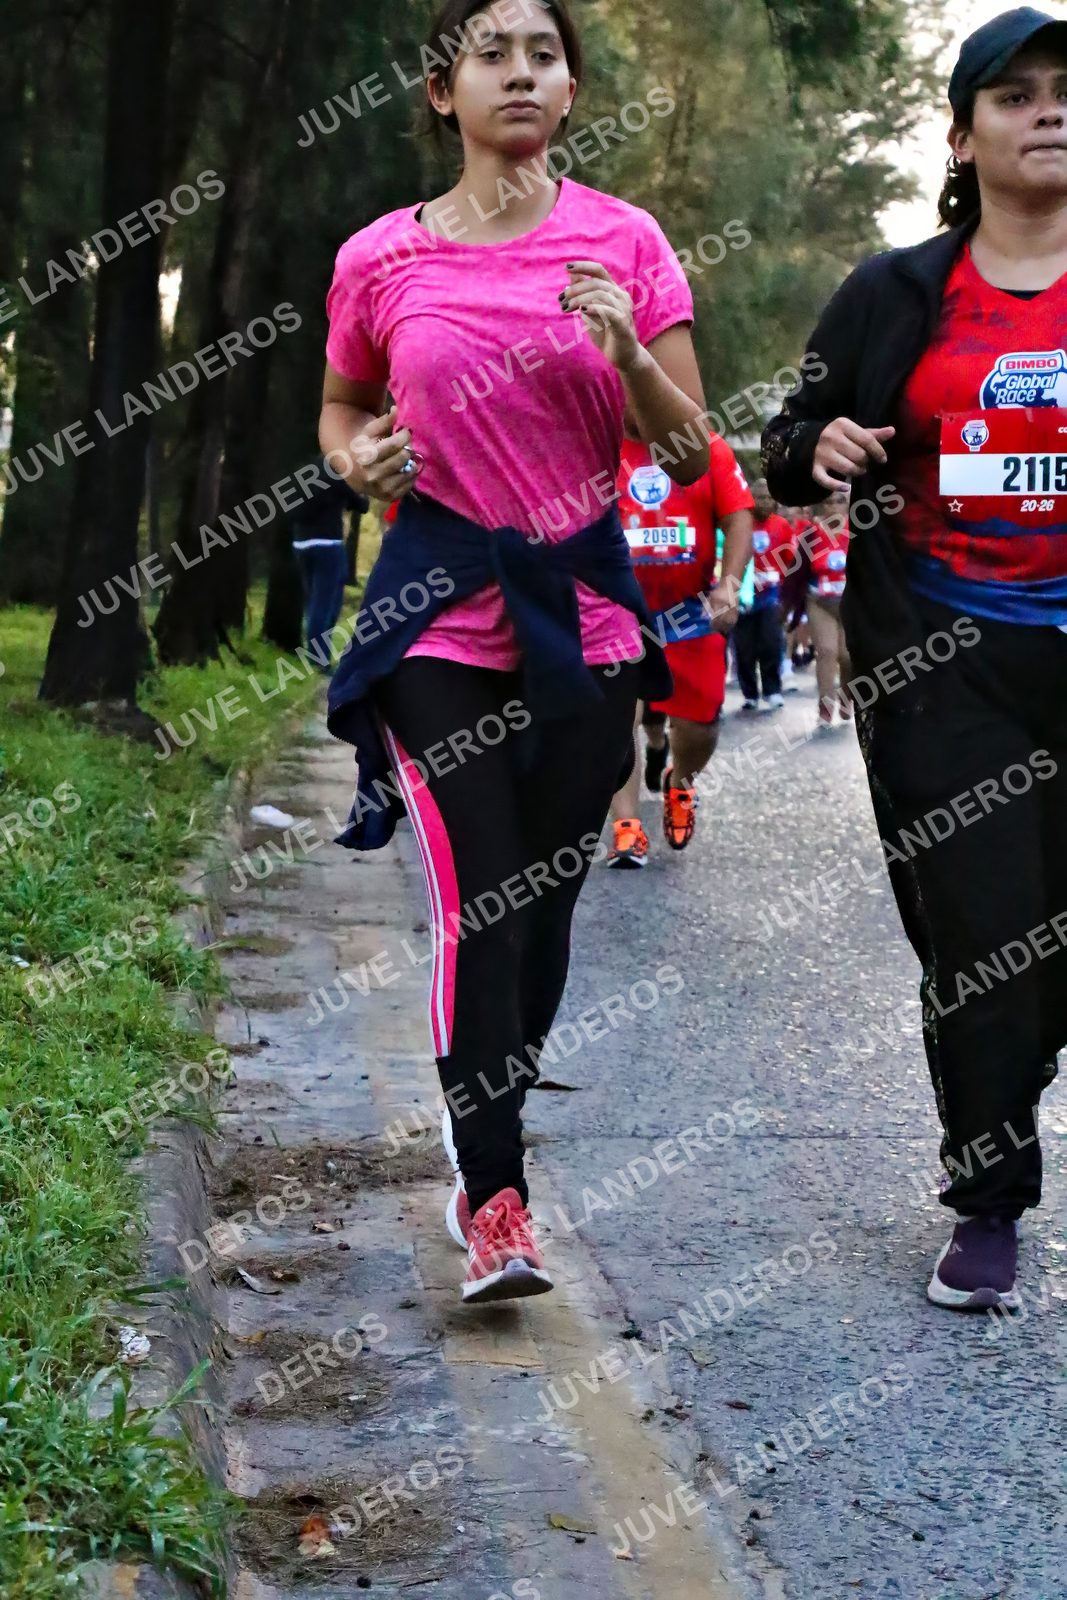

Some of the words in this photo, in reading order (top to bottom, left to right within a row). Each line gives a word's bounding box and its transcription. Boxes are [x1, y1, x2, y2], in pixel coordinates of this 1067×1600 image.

[1005, 359, 1057, 370] BIMBO
[1005, 373, 1056, 390] Global
[995, 388, 1036, 404] Race
[1002, 456, 1067, 492] 2115
[643, 528, 677, 544] 2099
